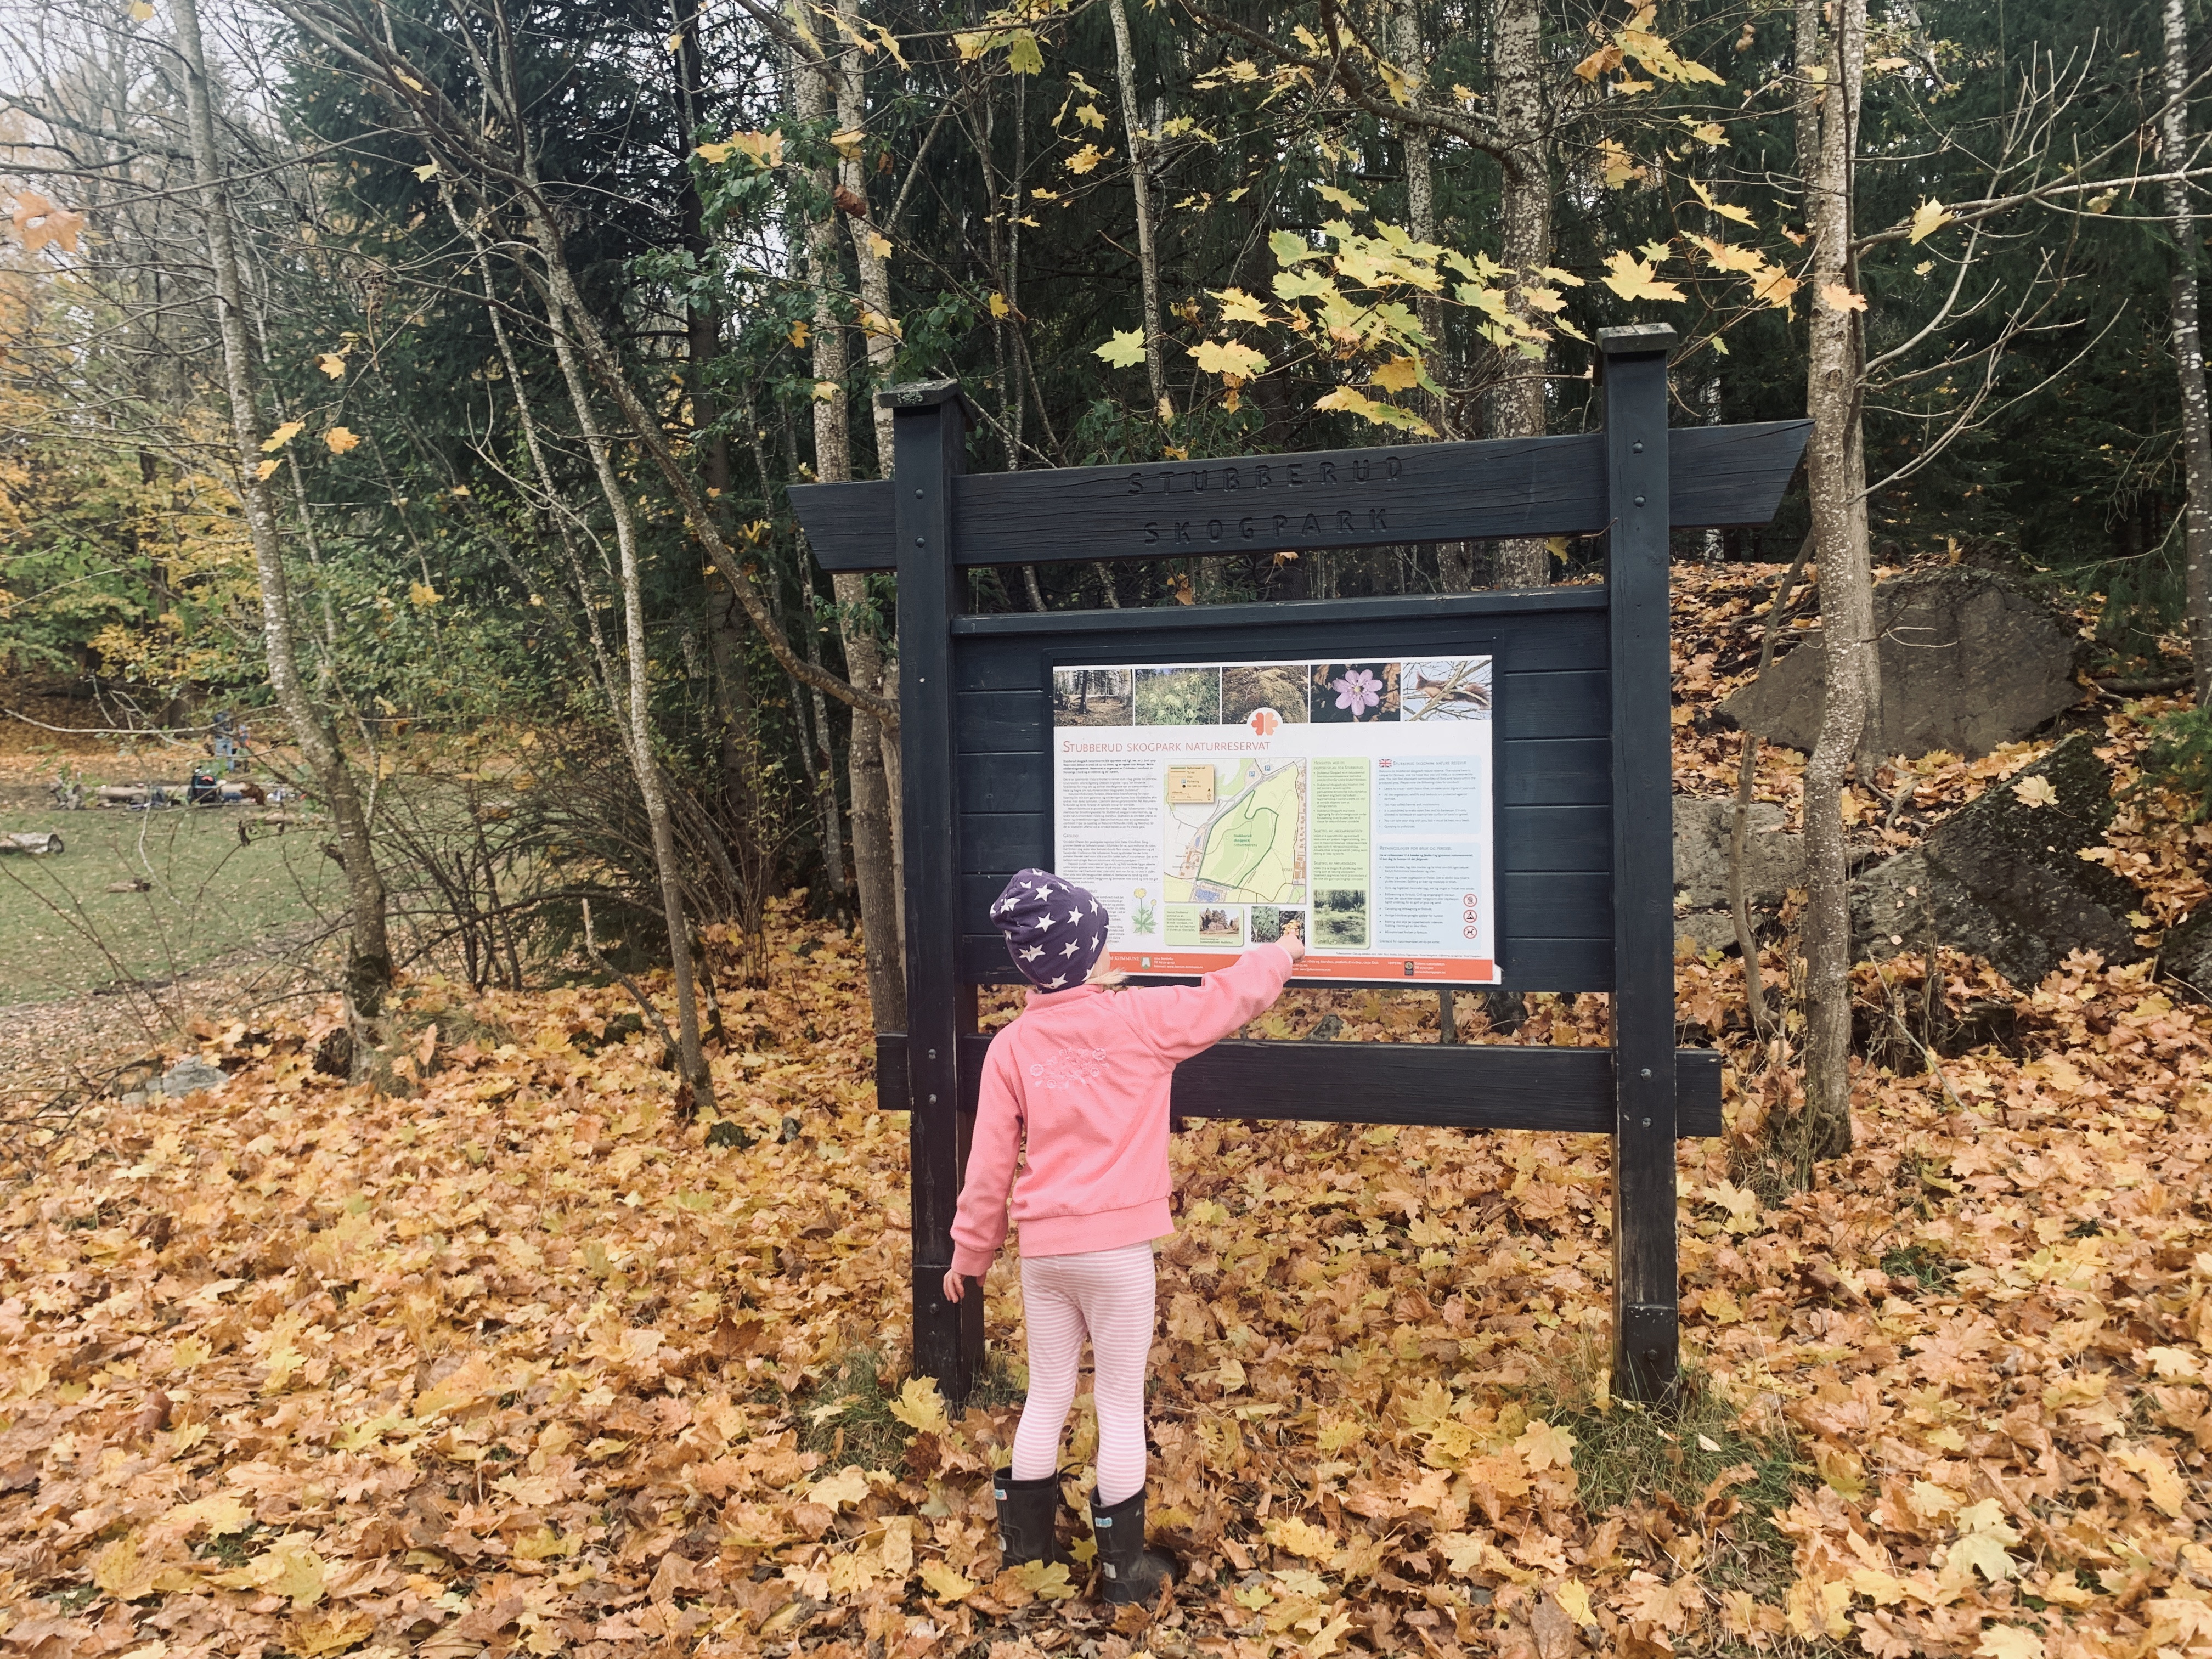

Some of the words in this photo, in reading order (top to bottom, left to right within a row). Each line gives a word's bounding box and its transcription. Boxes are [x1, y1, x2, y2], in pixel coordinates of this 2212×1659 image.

[1128, 456, 1402, 496] STUBBERUD
[1144, 509, 1387, 545] SKOGPARK
[1063, 741, 1122, 752] STUBBERUD
[1127, 742, 1181, 752] SKOGPARK
[1186, 741, 1271, 751] NATURRESERVAT
